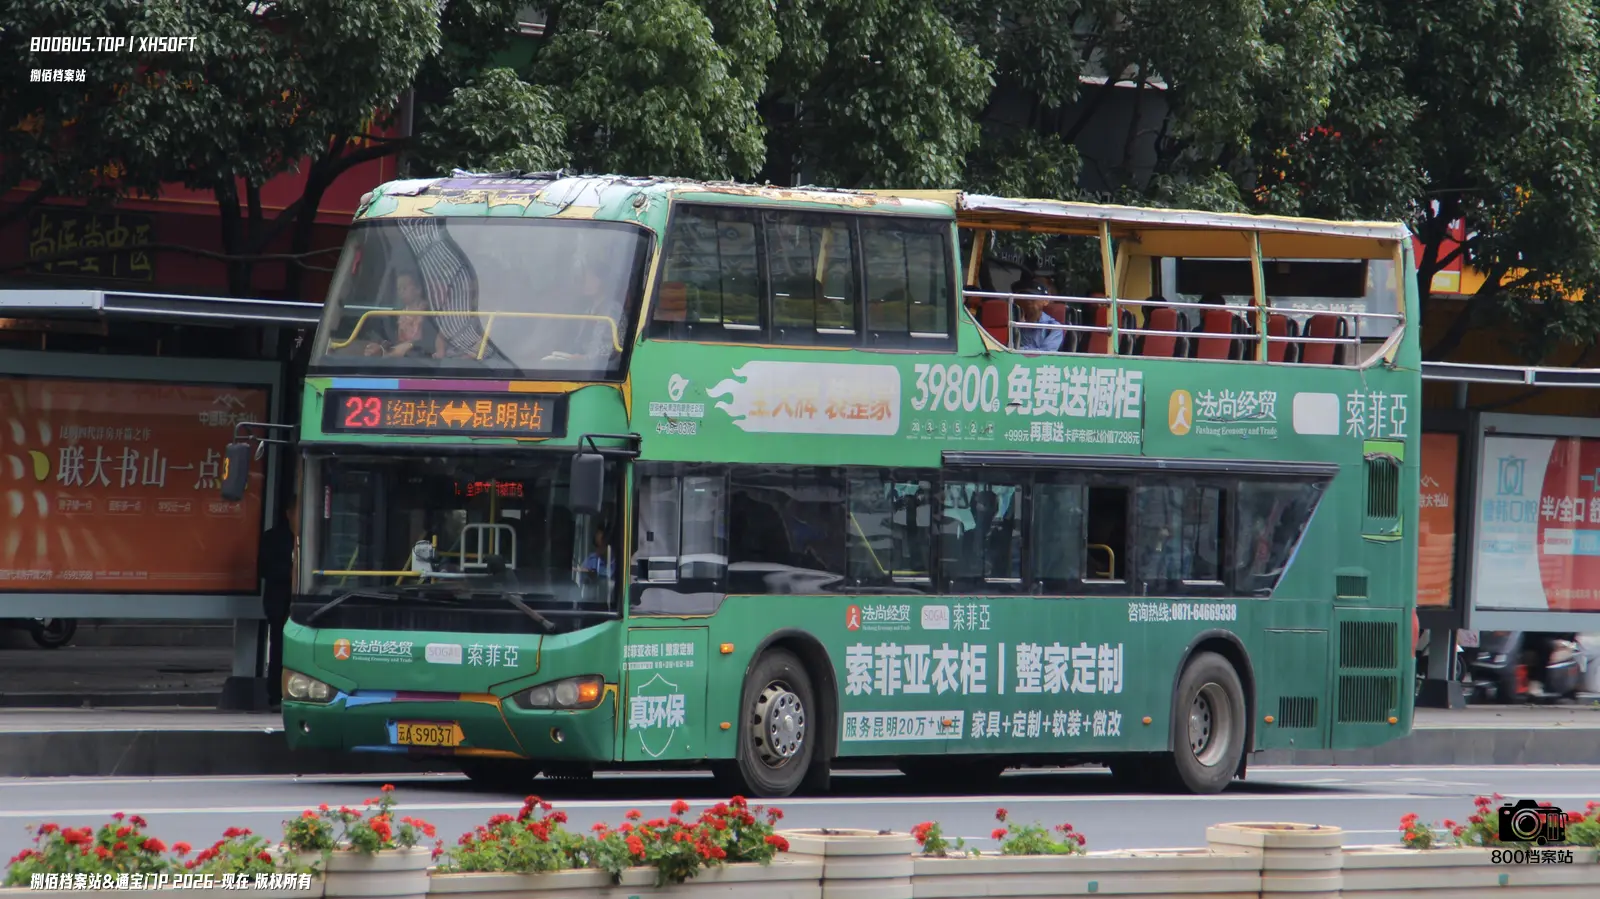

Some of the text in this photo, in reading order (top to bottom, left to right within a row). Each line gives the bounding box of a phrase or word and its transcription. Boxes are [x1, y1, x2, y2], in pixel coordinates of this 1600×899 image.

[1004, 364, 1143, 419] 免费送橱柜
[1195, 389, 1277, 420] 法尚经贸
[344, 396, 382, 427] 23
[472, 399, 543, 430] 昆明站
[862, 604, 911, 621] 法尚经贸
[352, 639, 413, 656] 法尚经贸
[844, 641, 988, 695] 索菲亚衣柜
[1015, 641, 1124, 694] 整家定制
[628, 693, 685, 730] 真环保
